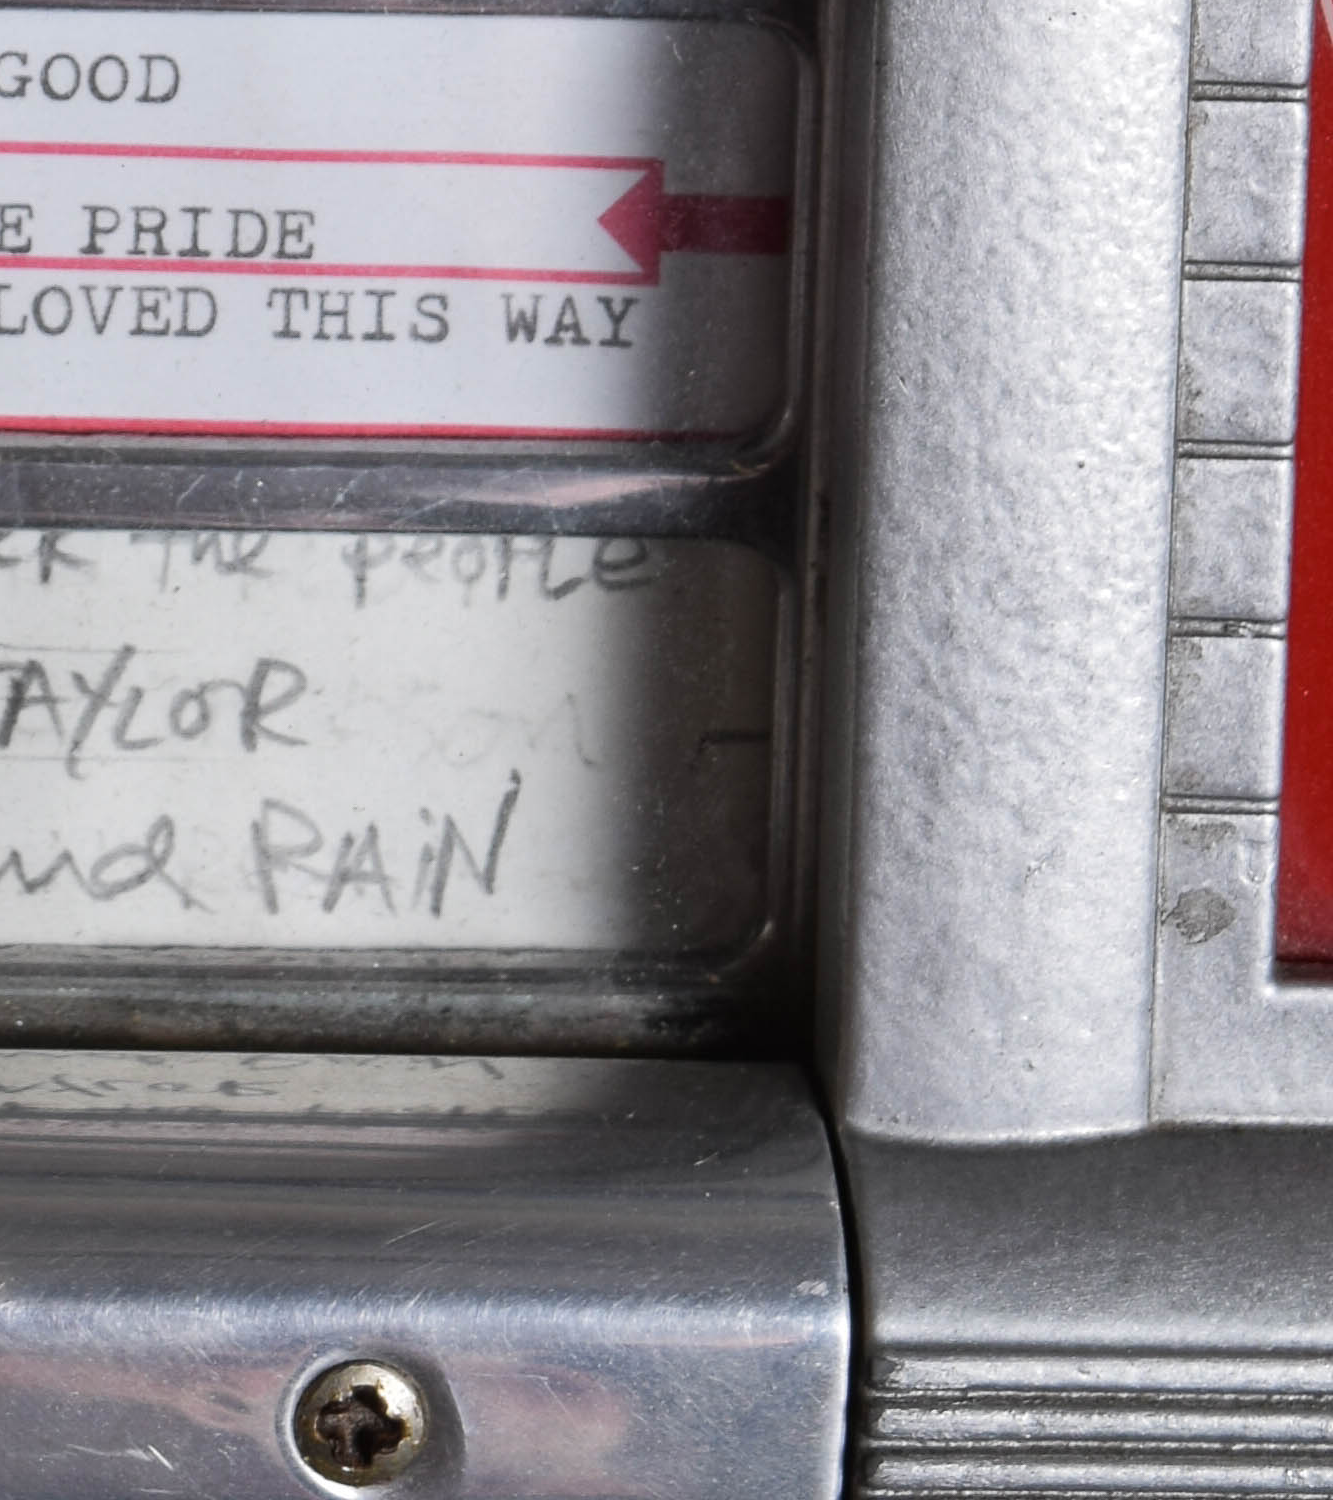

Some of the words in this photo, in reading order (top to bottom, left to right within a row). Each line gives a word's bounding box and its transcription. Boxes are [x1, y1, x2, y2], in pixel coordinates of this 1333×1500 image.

[78, 205, 315, 262] PRIDE
[266, 287, 450, 344] THIS
[501, 294, 638, 349] WAY
